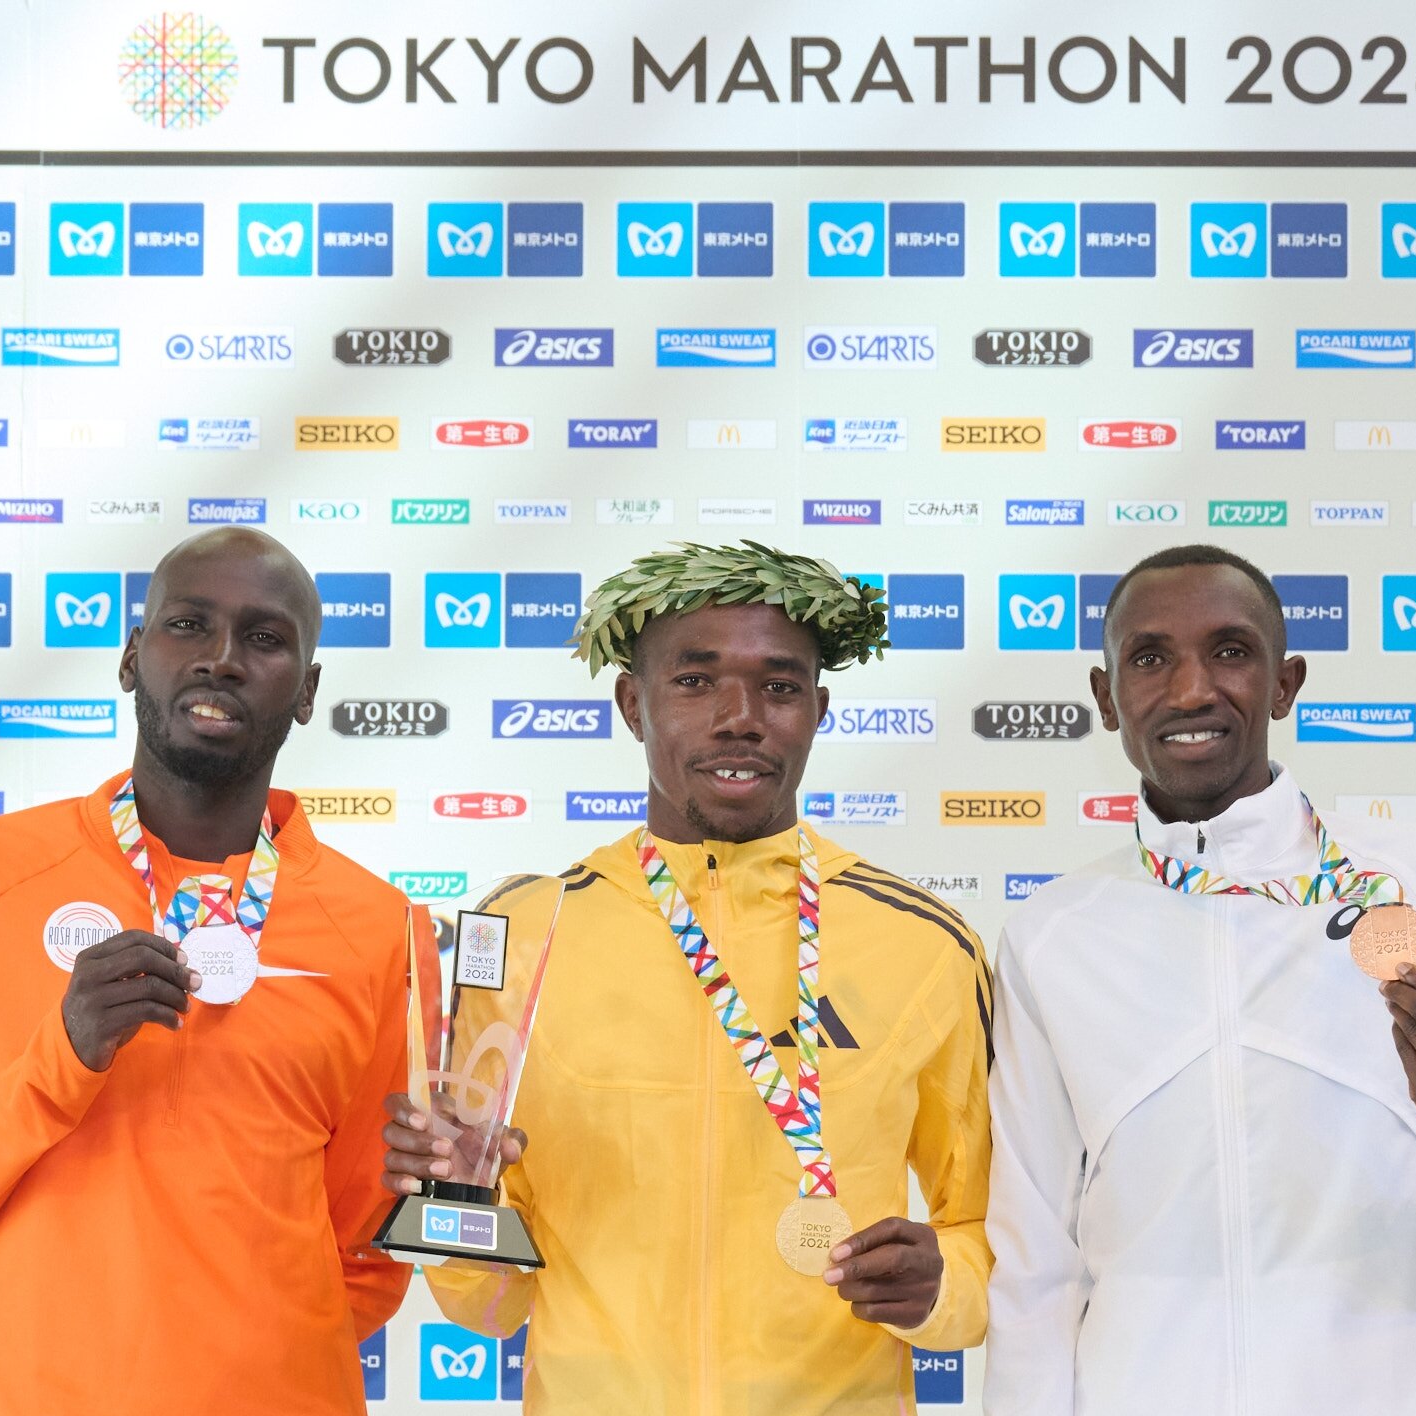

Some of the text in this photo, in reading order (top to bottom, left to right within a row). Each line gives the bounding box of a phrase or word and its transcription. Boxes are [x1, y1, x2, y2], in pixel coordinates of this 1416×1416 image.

[263, 37, 594, 103] TOKYO
[632, 36, 1186, 104] MARATHON
[347, 331, 438, 350] TOKIO
[661, 335, 770, 347] POCARI SWEAT
[357, 351, 429, 363] インカラミ
[946, 425, 1042, 444] SEIKO
[813, 503, 871, 516] MIZUHO
[1008, 504, 1077, 523] Salonpas
[533, 709, 599, 731] asics
[443, 797, 517, 815] 第一生命
[48, 926, 71, 946] ROSA
[1374, 929, 1408, 939] TOKYO
[1375, 942, 1408, 955] 2024
[201, 951, 234, 959] TOKYO
[466, 955, 496, 965] TOKYO
[201, 965, 234, 976] 2024
[465, 968, 494, 980] 2024
[800, 1223, 832, 1233] TOKYO
[799, 1237, 831, 1249] 2024
